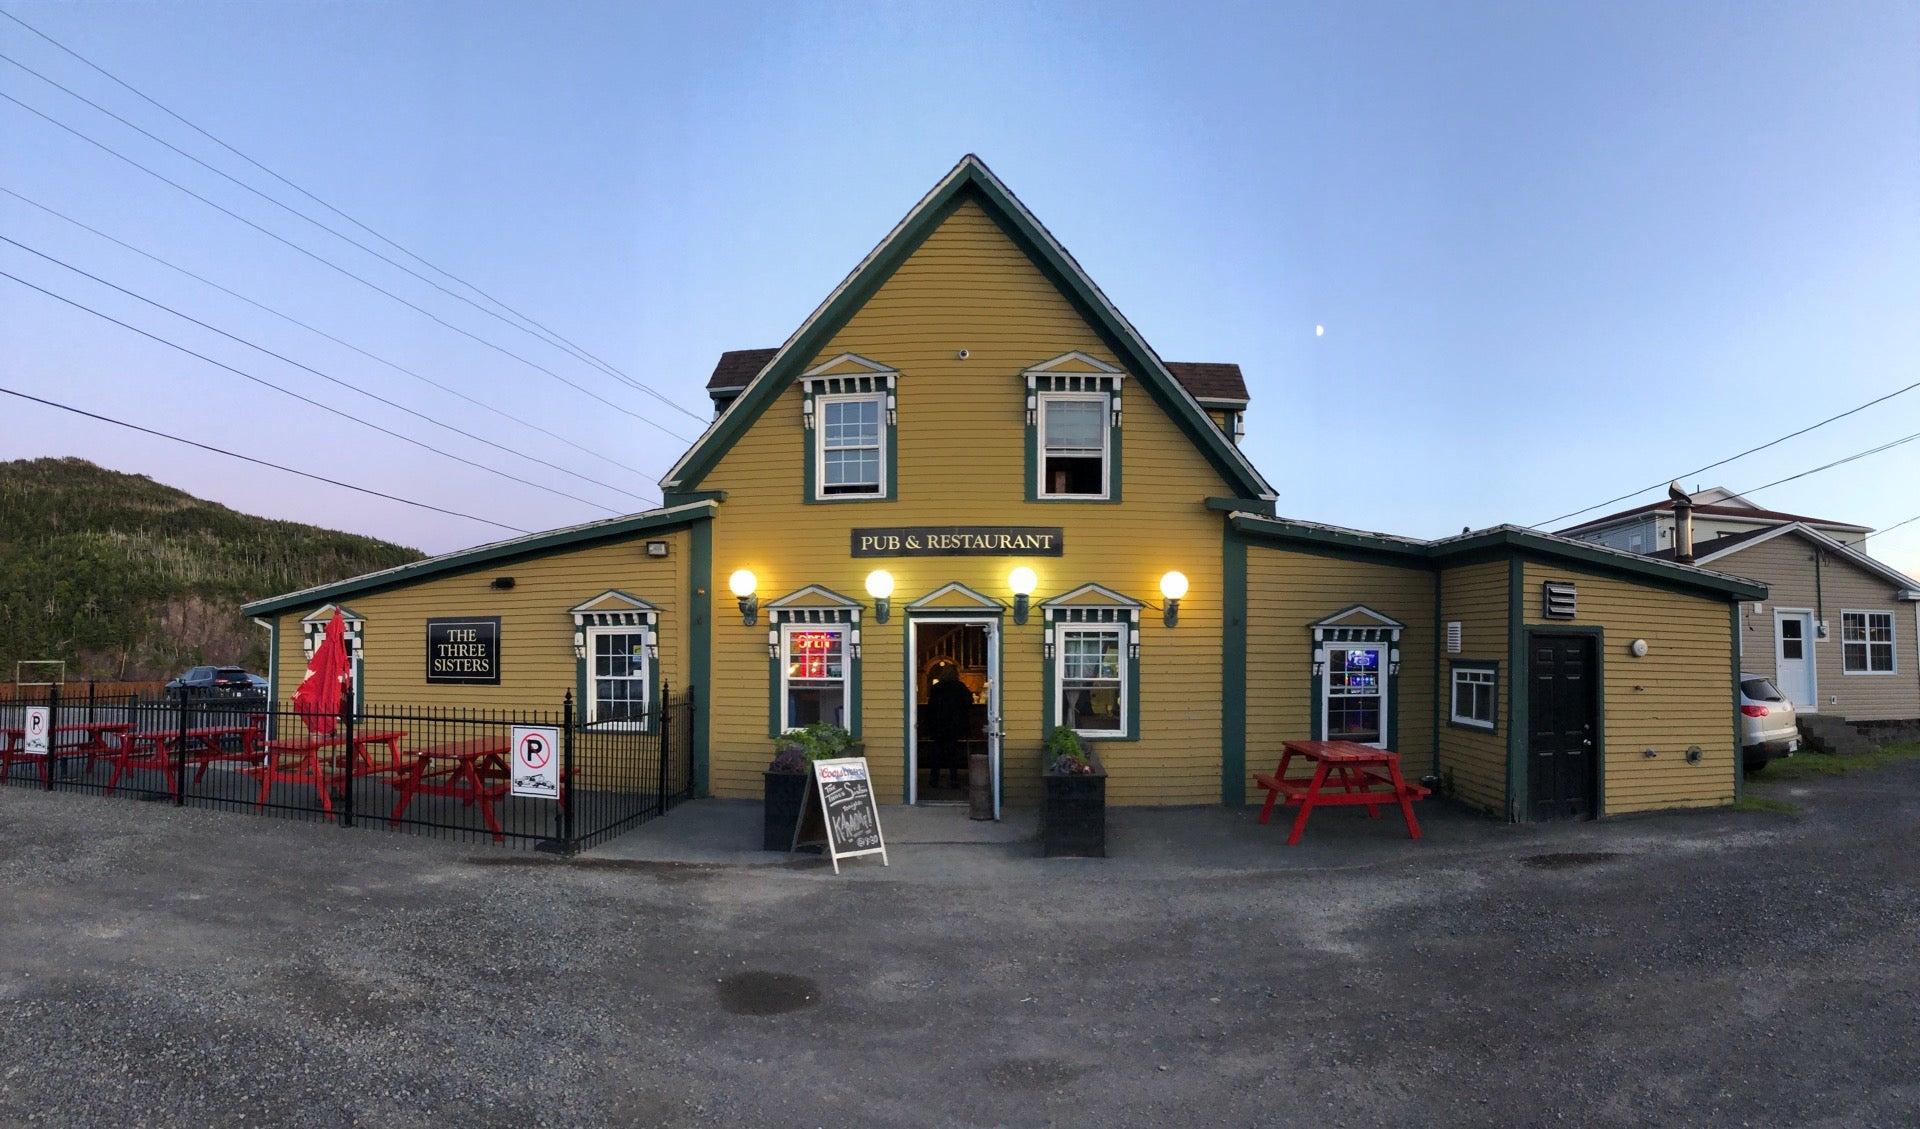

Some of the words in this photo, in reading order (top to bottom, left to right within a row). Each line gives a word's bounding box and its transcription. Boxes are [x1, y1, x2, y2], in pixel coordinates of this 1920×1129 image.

[861, 536, 900, 550] PUB
[905, 535, 922, 549] &
[927, 534, 1053, 549] RESTAURANT
[447, 629, 477, 642] THE
[798, 634, 831, 649] OPEN
[438, 644, 486, 657] THREE
[434, 658, 489, 672] SISTERS
